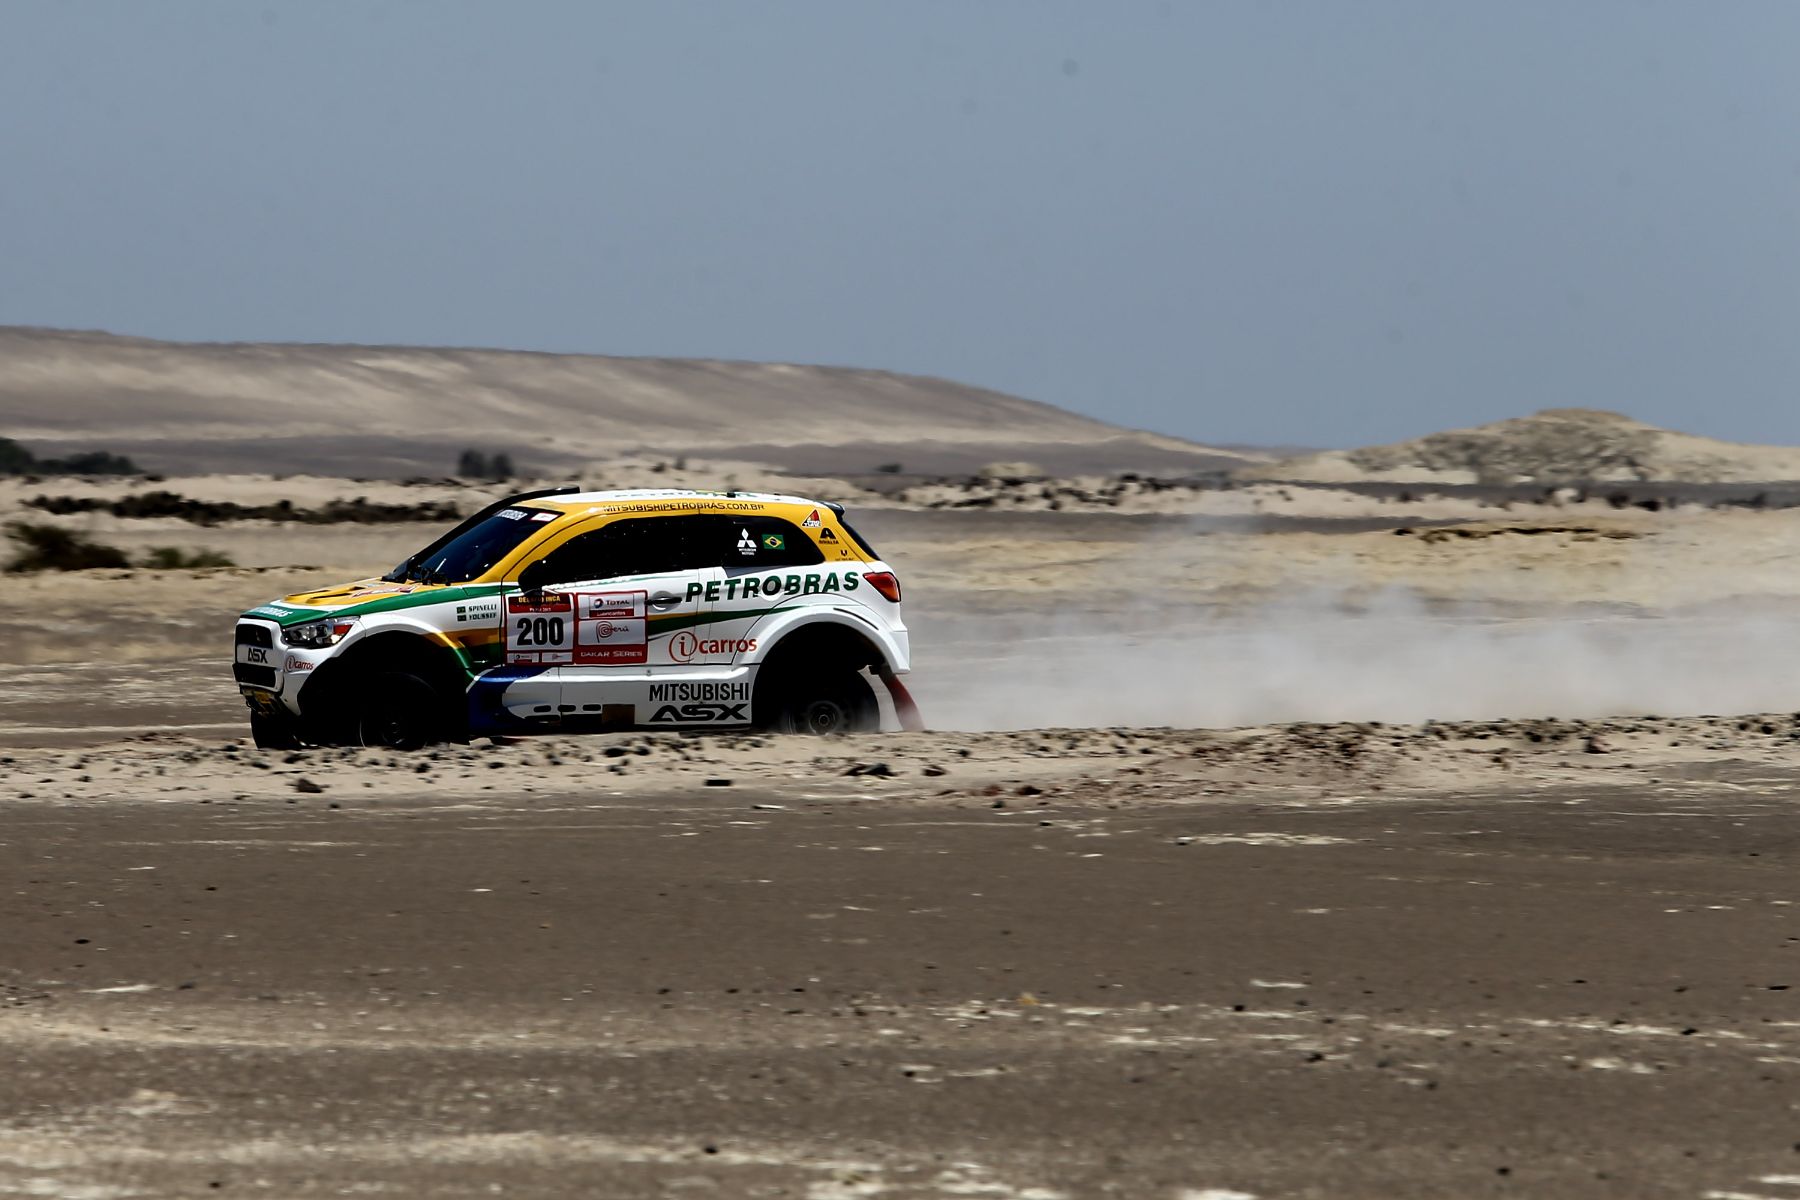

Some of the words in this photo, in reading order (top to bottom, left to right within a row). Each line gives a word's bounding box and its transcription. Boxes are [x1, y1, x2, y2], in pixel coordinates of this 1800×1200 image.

[685, 571, 859, 603] PETROBRAS
[468, 603, 497, 612] SPINELLI
[468, 612, 497, 621] YOUSSEF
[517, 617, 564, 646] 200
[247, 647, 268, 664] ASX
[649, 682, 749, 702] MITSUBISHI
[649, 703, 749, 722] ASX
